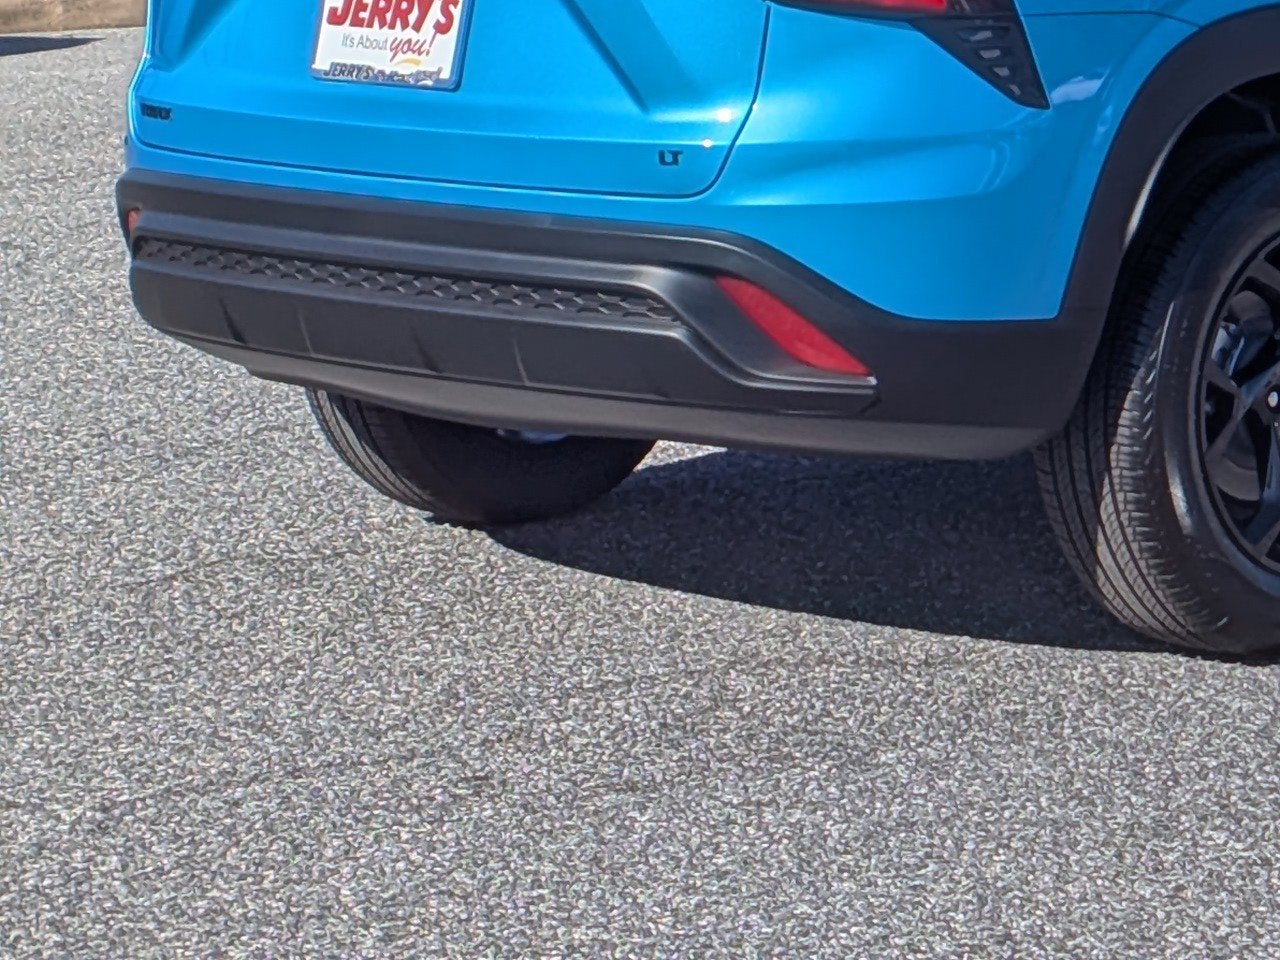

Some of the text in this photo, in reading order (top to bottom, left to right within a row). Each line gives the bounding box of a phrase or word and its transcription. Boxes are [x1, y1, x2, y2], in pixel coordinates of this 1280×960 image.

[341, 30, 438, 63] It's About you!
[658, 149, 684, 167] LT
